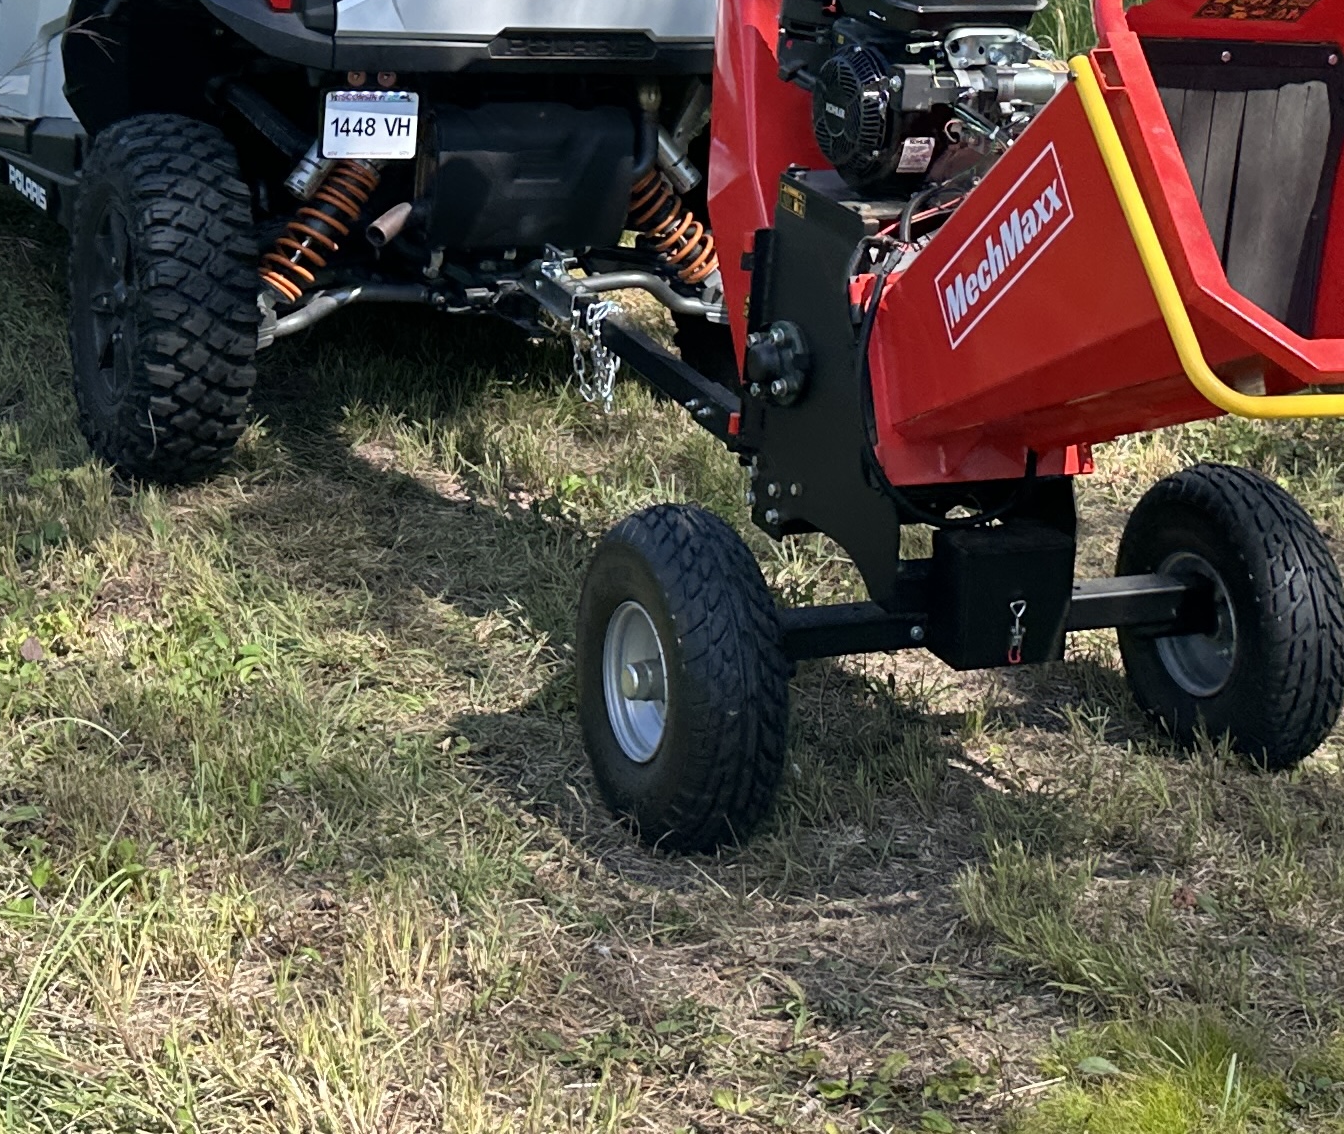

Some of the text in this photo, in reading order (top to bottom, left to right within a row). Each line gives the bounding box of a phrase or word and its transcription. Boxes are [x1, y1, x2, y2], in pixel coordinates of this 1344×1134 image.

[331, 117, 411, 137] 1448 VH
[9, 164, 47, 211] POLARIS
[945, 178, 1063, 329] MechMaxx
